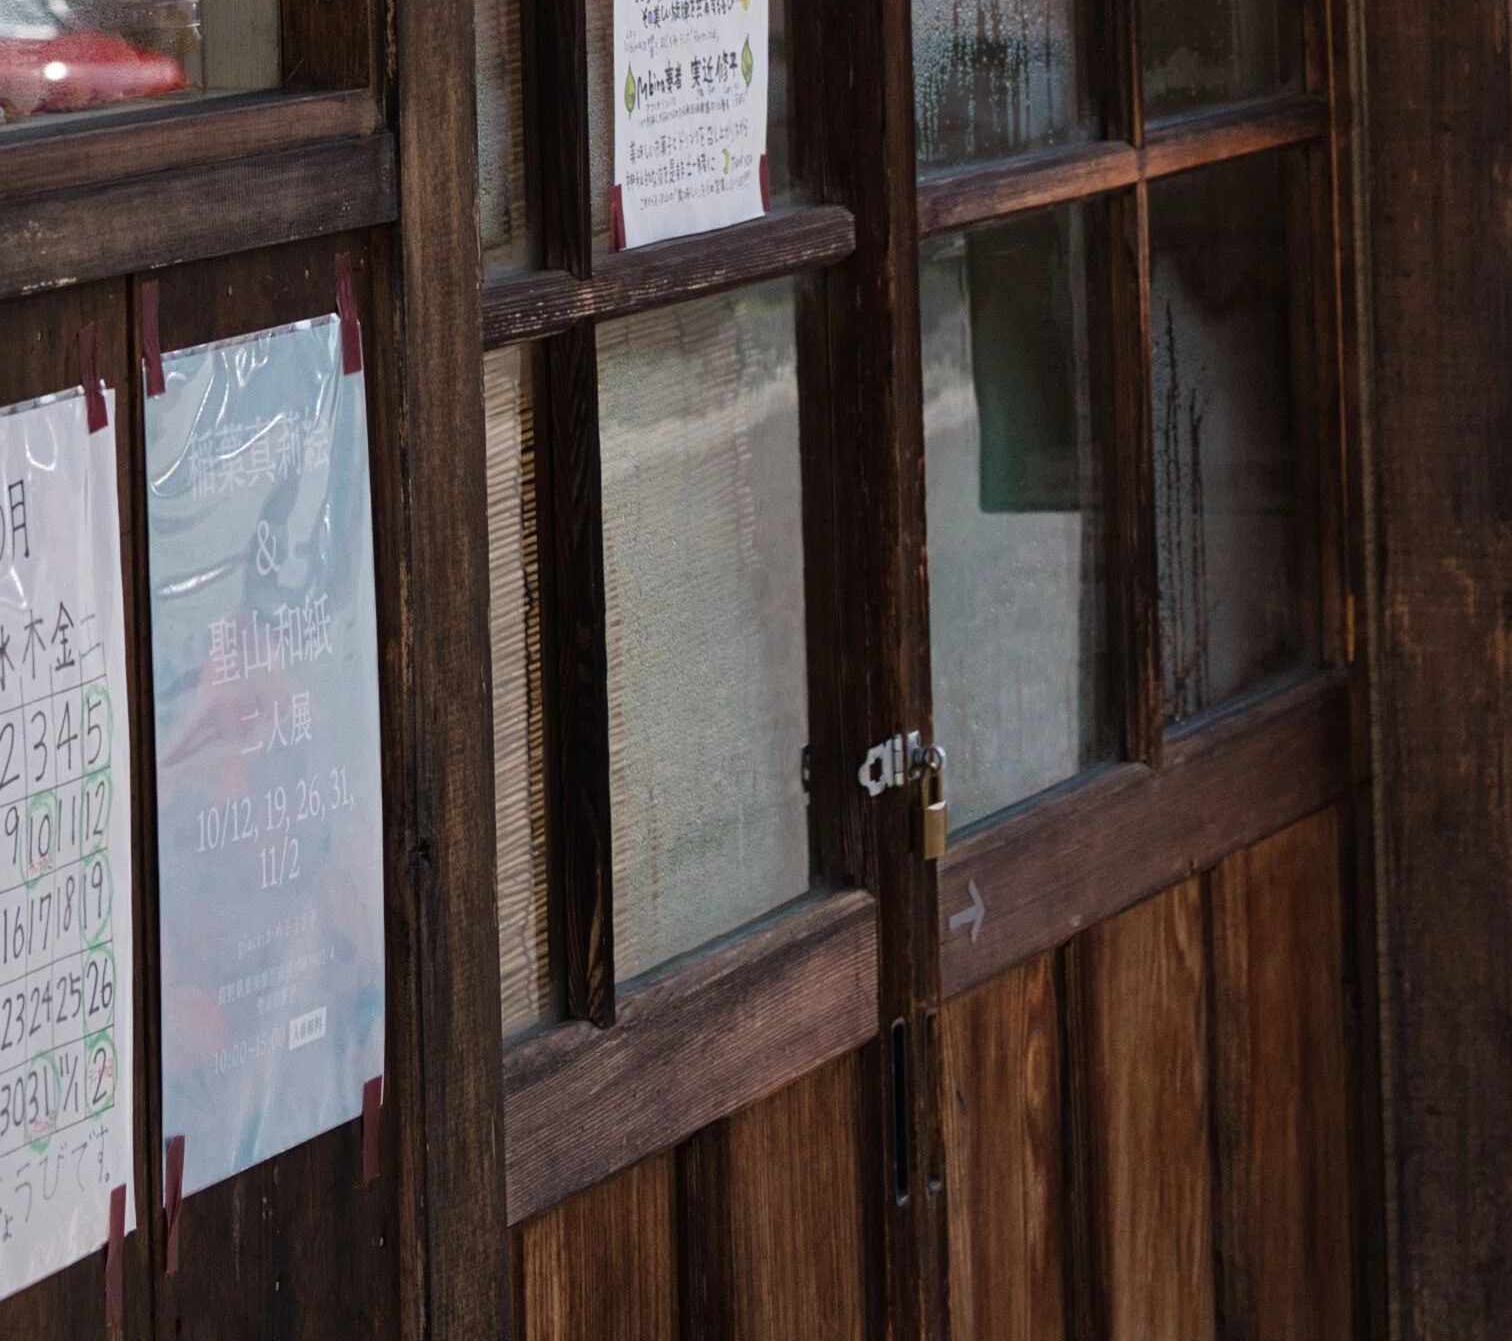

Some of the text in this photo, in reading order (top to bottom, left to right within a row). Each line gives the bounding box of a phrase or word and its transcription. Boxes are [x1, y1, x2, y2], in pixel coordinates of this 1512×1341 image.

[256, 520, 280, 576] &
[22, 608, 46, 680] 木
[51, 600, 76, 671] 金
[208, 585, 333, 686] 聖山和紙
[31, 710, 48, 782] 3
[56, 701, 78, 770] 4
[86, 698, 102, 765] 5
[241, 691, 312, 755] 二人展
[5, 805, 19, 865] 9
[29, 814, 51, 865] 10
[57, 795, 76, 853] 11
[85, 781, 105, 841] 12
[197, 765, 354, 852] 10/12, 19, 26, 31,
[260, 836, 301, 889] 11/2
[3, 905, 25, 964] 16
[28, 893, 52, 955] 17
[57, 875, 75, 940] 18
[82, 861, 103, 930] 19
[0, 993, 25, 1051] 23
[29, 980, 52, 1037] 24
[56, 972, 81, 1023] 25
[86, 958, 113, 1017] 26
[0, 1077, 25, 1137] 30
[28, 1065, 49, 1124] 31
[92, 1047, 107, 1105] 2
